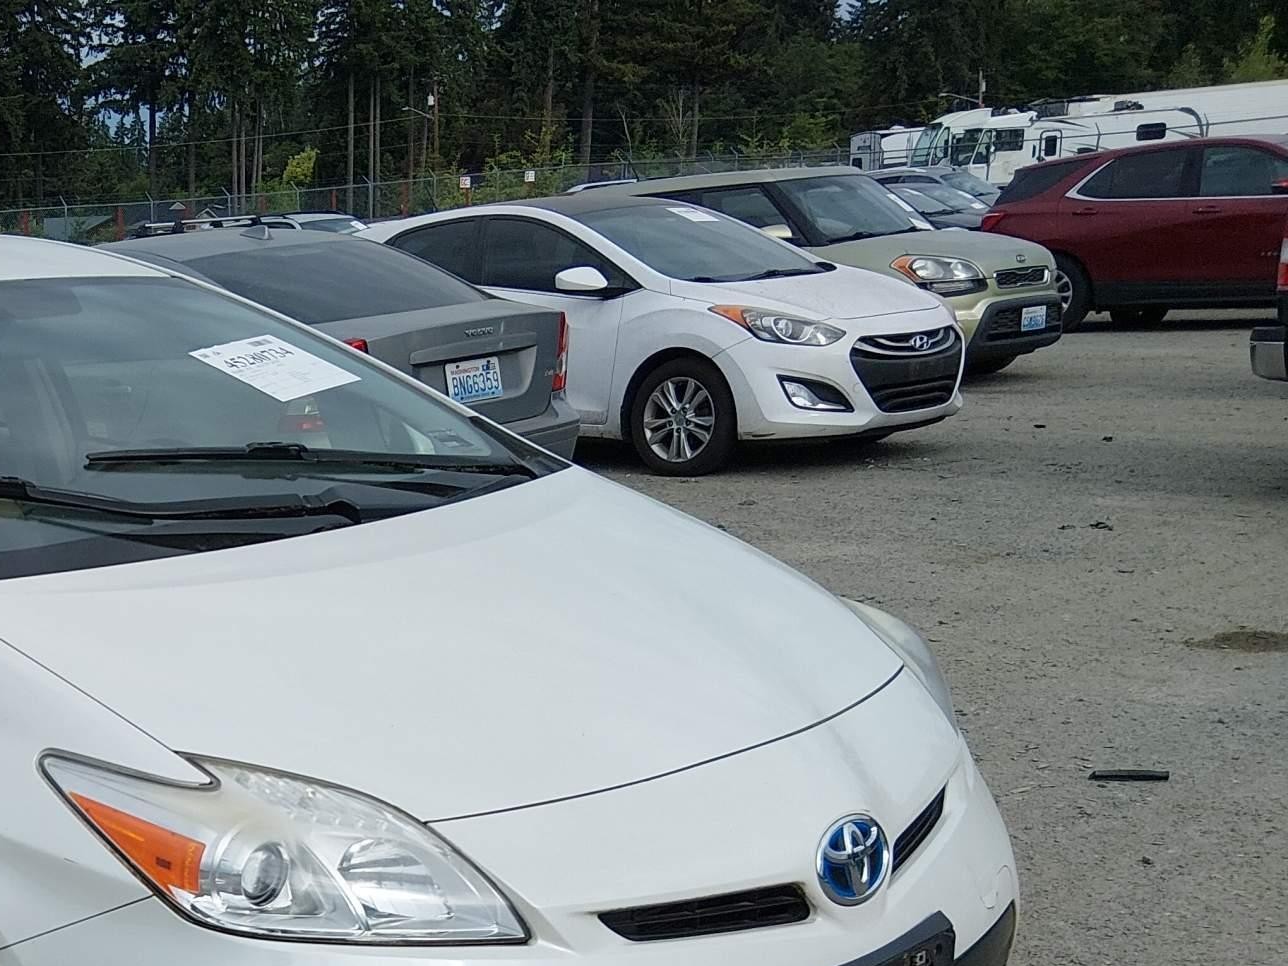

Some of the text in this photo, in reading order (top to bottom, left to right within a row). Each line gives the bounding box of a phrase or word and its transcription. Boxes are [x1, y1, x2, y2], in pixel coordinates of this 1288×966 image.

[463, 326, 494, 338] VOLVO
[223, 346, 296, 370] 45280734
[452, 371, 500, 397] BNG6359
